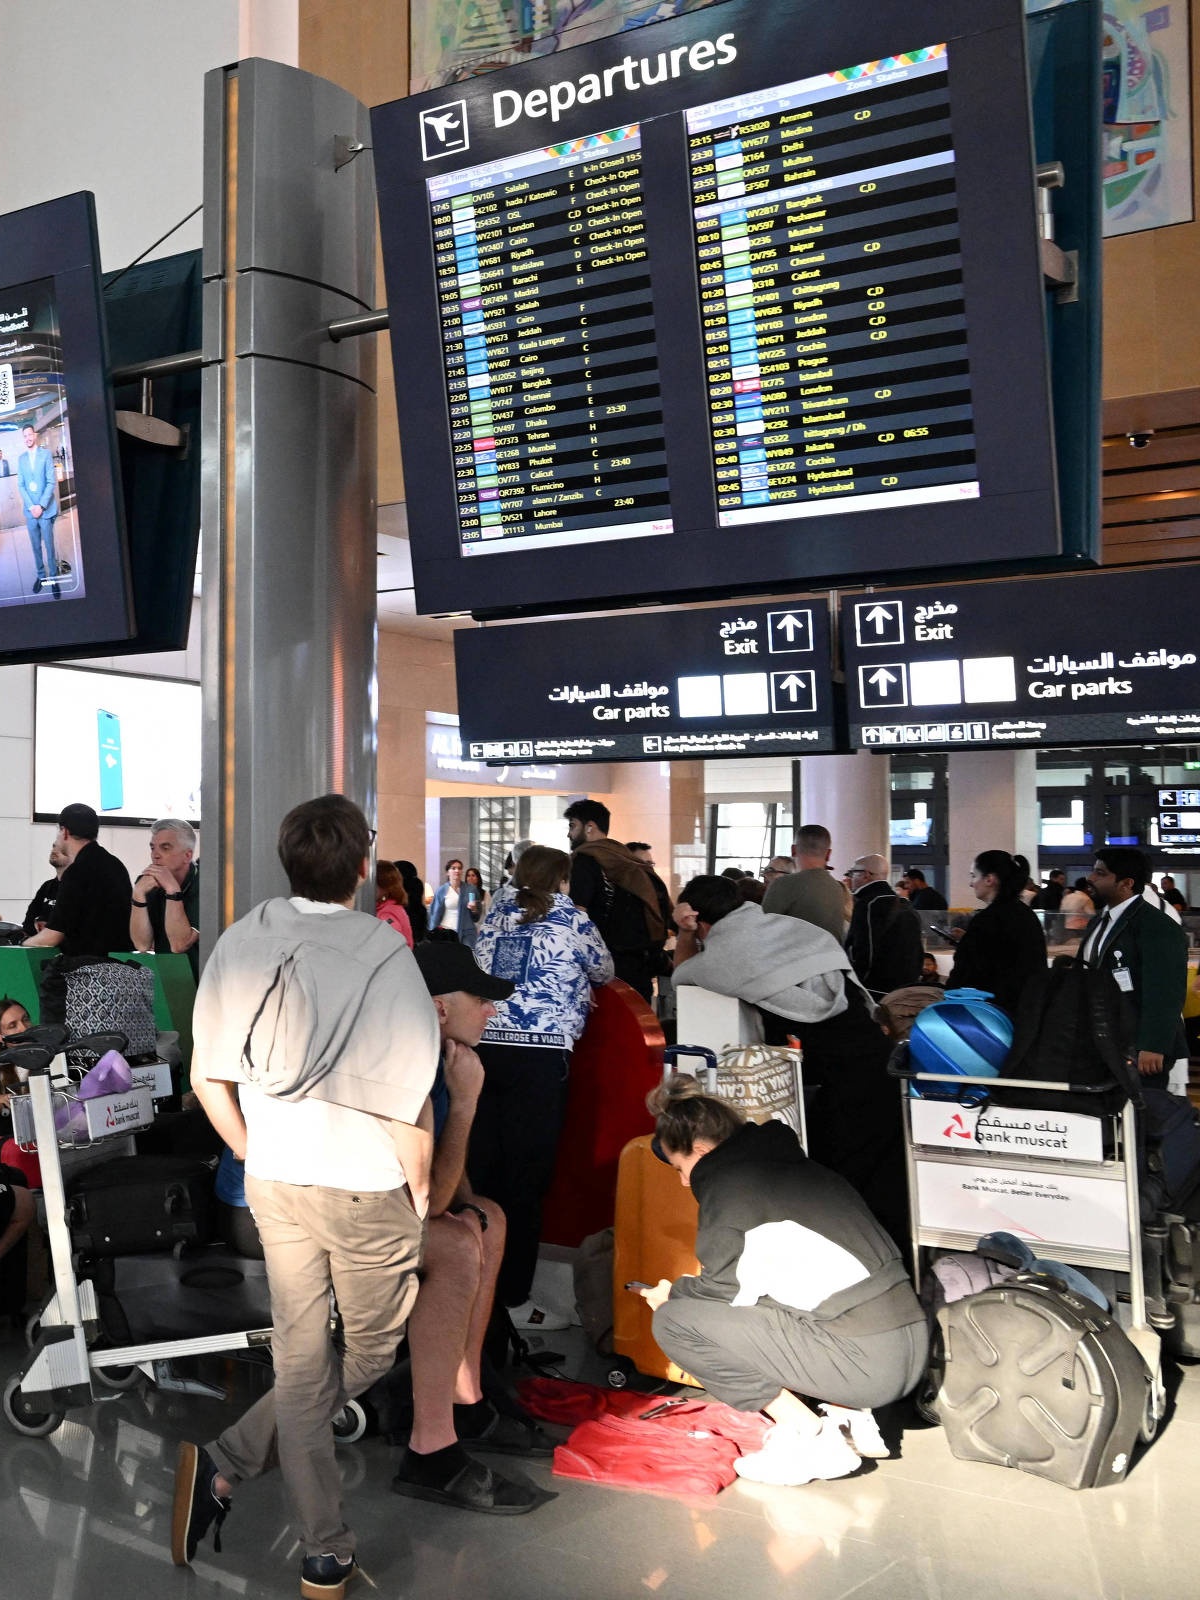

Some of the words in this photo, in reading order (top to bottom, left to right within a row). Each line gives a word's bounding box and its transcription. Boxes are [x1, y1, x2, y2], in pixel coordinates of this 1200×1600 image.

[493, 33, 737, 128] Departures
[779, 110, 812, 124] Amman
[781, 140, 803, 153] Delhi
[558, 153, 579, 166] Zone
[582, 146, 608, 159] Status
[584, 173, 616, 186] Check-In
[617, 168, 638, 178] Open
[783, 168, 815, 181] Bahrain
[432, 202, 449, 212] 17:45
[504, 182, 529, 193] Salalah
[599, 156, 624, 168] Closed
[585, 187, 618, 199] Check-In
[619, 182, 640, 192] Open
[436, 240, 453, 250] 18:05
[508, 222, 534, 233] London
[586, 200, 619, 213] Check-In
[620, 196, 641, 206] Open
[786, 209, 826, 223] Peshawar
[509, 237, 527, 245] Cairo
[510, 248, 534, 259] Riyadh
[589, 228, 621, 240] Check-In
[622, 223, 643, 233] Open
[788, 241, 814, 252] Jaipur
[439, 279, 456, 288] 19:00
[511, 260, 544, 272] Bratislava
[590, 241, 622, 253] Check-In
[623, 237, 644, 247] Open
[512, 273, 538, 285] Karachi
[513, 286, 538, 298] Madrid
[791, 281, 839, 295] Chittagong
[443, 317, 460, 326] 21:00
[515, 300, 539, 311] Salalah
[516, 315, 534, 324] Cairo
[517, 326, 541, 337] Jeddah
[795, 326, 826, 338] Jeddah
[446, 355, 463, 364] 21:35
[518, 340, 537, 350] Kuala
[538, 336, 565, 346] Lumpur
[519, 354, 538, 362] Cairo
[797, 356, 828, 366] Prague
[520, 366, 544, 376] Beijing
[450, 393, 467, 402] 22:05
[522, 377, 551, 389] Bangkok
[523, 390, 551, 401] Chennai
[800, 384, 832, 395] London
[524, 404, 555, 414] Colombo
[453, 431, 470, 439] 22:20
[525, 418, 547, 427] Dhaka
[606, 404, 626, 414] 23:30
[526, 432, 549, 440] Tehran
[527, 442, 556, 453] Mumbai
[804, 442, 834, 452] Jakarta
[456, 468, 474, 477] 22:30
[528, 456, 552, 466] Phuket
[530, 469, 553, 478] Calicut
[610, 457, 630, 467] 23:40
[806, 467, 853, 481] Hyderabad
[531, 481, 564, 491] Fiumicino
[460, 506, 477, 514] 22:45
[533, 509, 557, 517] Lahore
[534, 521, 563, 529] Mumbai
[914, 601, 958, 623] مخرج
[719, 617, 758, 637] مخرج
[915, 623, 954, 641] Exit
[724, 639, 758, 656] Exit
[1027, 652, 1114, 675] السيارات
[1119, 649, 1197, 669] مواقف
[549, 683, 611, 703] السيارات
[613, 682, 668, 698] مواقف
[1028, 681, 1063, 699] Car
[1071, 677, 1133, 700] parks
[593, 705, 622, 721] Car
[625, 703, 671, 722] parks
[1035, 1120, 1068, 1136] بنك
[1015, 1135, 1068, 1149] muscat
[962, 1183, 979, 1191] Bank
[1011, 1188, 1033, 1197] Better
[1035, 1191, 1071, 1201] Everyday.
